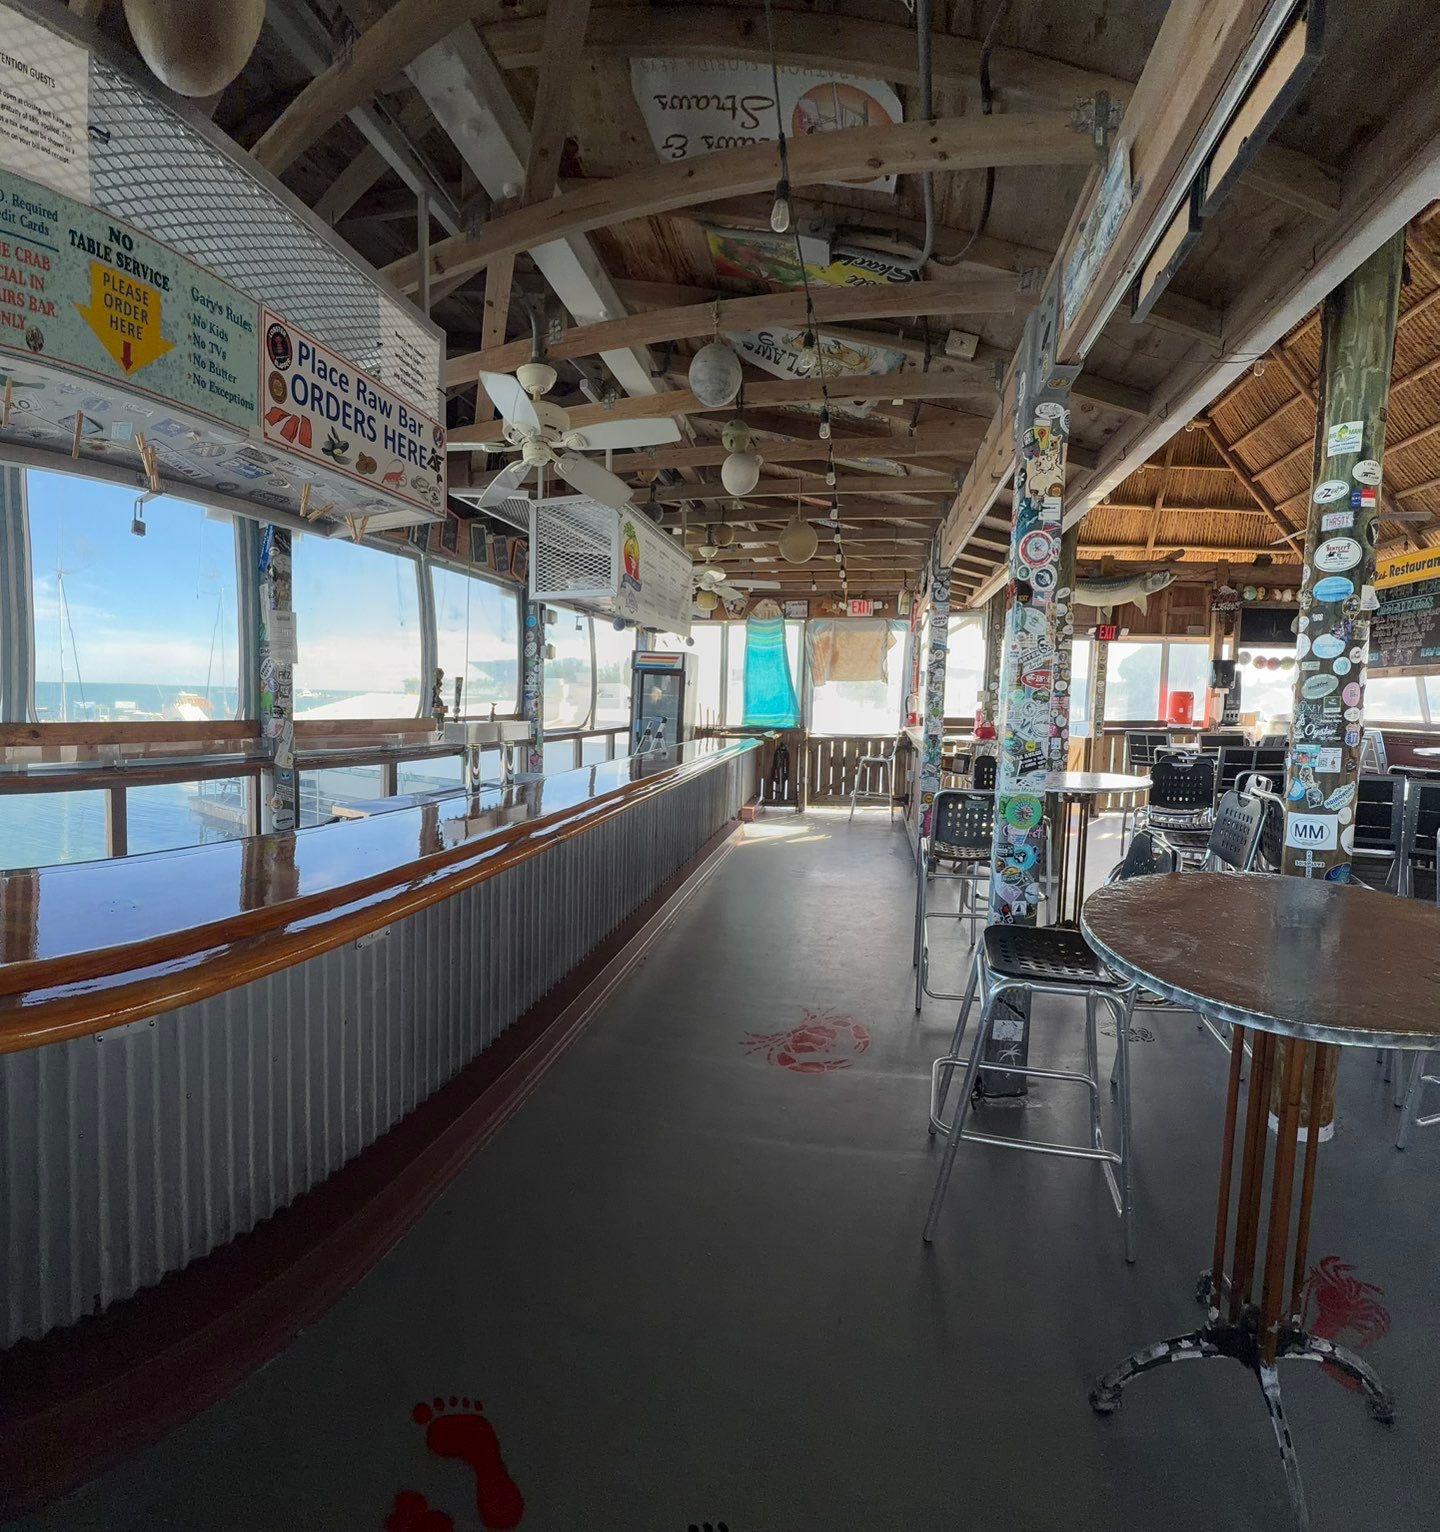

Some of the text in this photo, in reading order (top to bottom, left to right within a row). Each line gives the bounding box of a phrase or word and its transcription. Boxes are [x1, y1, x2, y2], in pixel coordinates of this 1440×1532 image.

[30, 68, 56, 88] GUESTS
[0, 103, 22, 117] gratuity
[22, 112, 28, 120] of
[3, 90, 16, 102] open
[24, 101, 41, 114] closing
[654, 94, 775, 130] Straws
[10, 120, 18, 128] tax
[19, 124, 28, 132] and
[19, 137, 30, 146] your
[40, 144, 50, 155] and
[12, 194, 58, 222] Required
[20, 214, 49, 236] Cards
[108, 226, 133, 250] NO
[14, 246, 51, 272] CRAB
[69, 228, 170, 292] TABLE SERVICE
[30, 274, 45, 292] IN
[103, 272, 149, 307] PLEASE
[29, 295, 56, 318] BAR
[104, 292, 149, 325] ORDER
[191, 287, 253, 333] Gary's Rules
[110, 315, 143, 341] HERE
[192, 313, 229, 342] No Kids
[192, 333, 227, 361] No TVs
[192, 352, 238, 384] No Butter
[192, 372, 255, 411] No Exceptions
[298, 341, 349, 393] Place
[356, 378, 392, 419] Raw
[399, 406, 424, 438] Bar
[291, 374, 427, 470] ORDERS HERE
[852, 602, 872, 614] EXIT
[1099, 625, 1117, 639] EXIT
[1304, 723, 1336, 740] Oyster
[1294, 823, 1324, 840] MM
